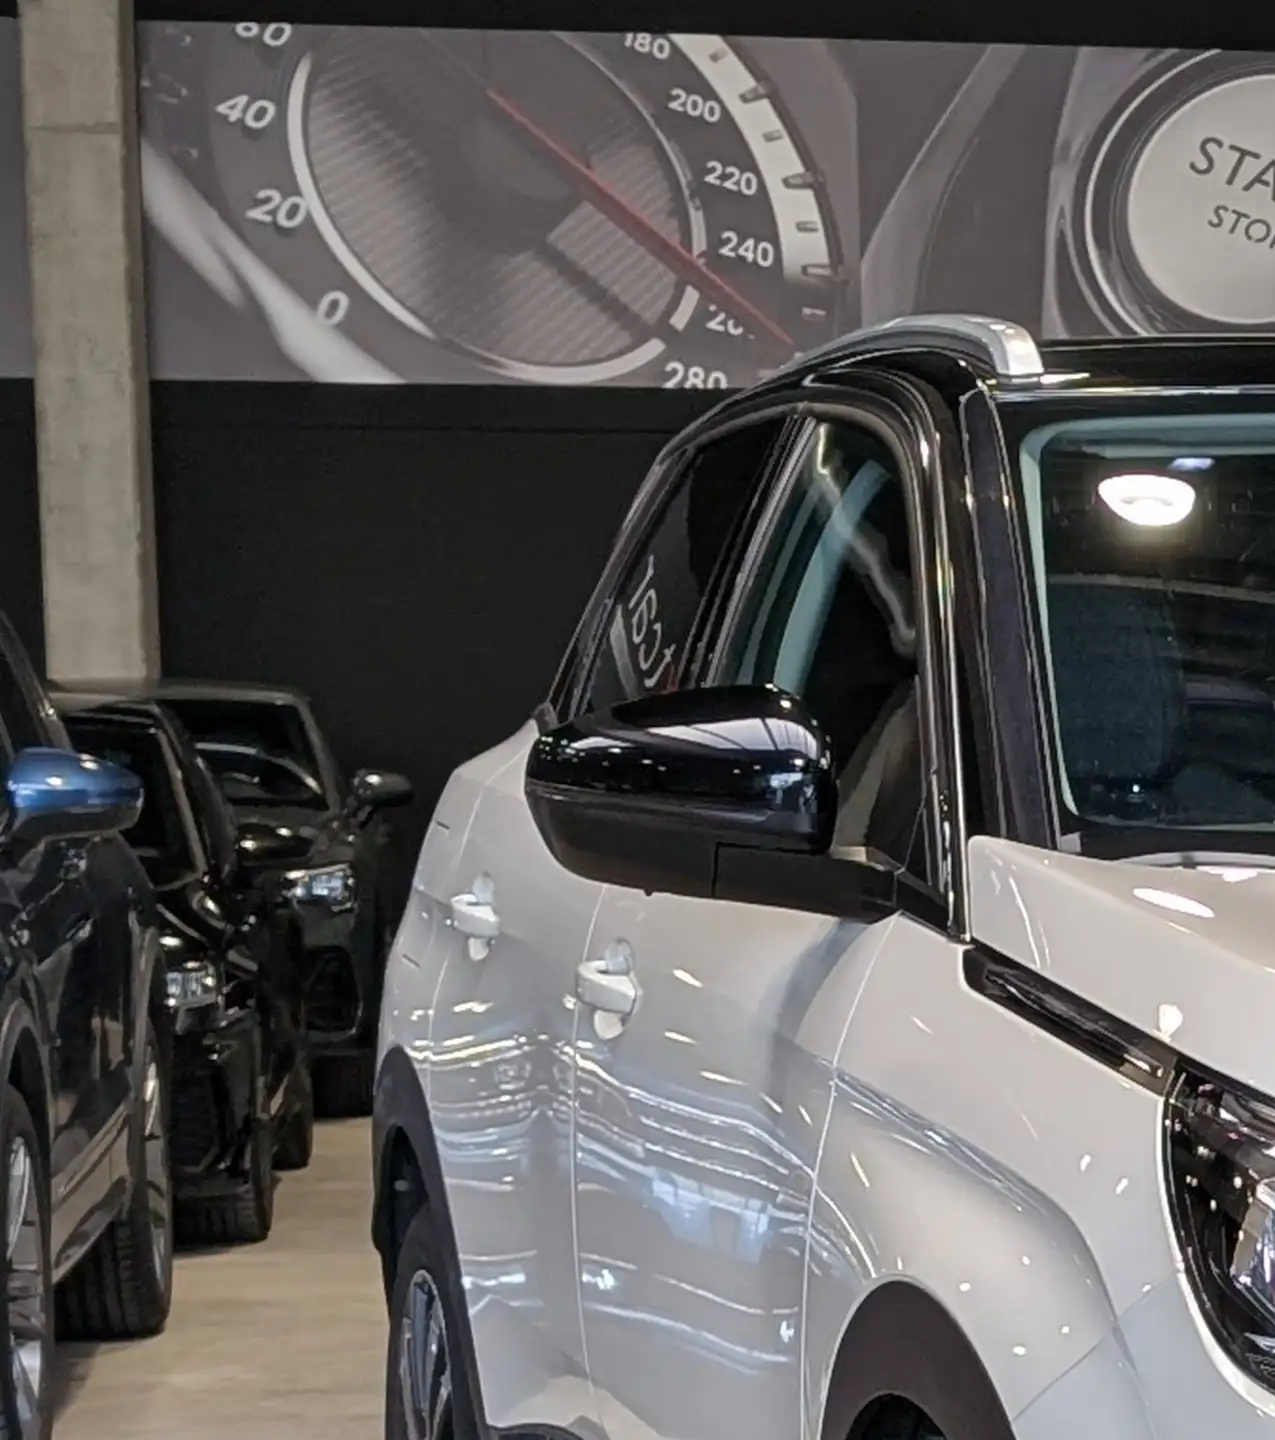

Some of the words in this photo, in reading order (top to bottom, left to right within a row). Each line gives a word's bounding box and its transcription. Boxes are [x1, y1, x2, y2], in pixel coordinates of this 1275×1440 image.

[214, 93, 277, 131] 40
[666, 87, 722, 123] 200
[703, 160, 758, 196] 220
[244, 188, 308, 229] 20
[717, 230, 775, 268] 240
[315, 290, 351, 327] 0
